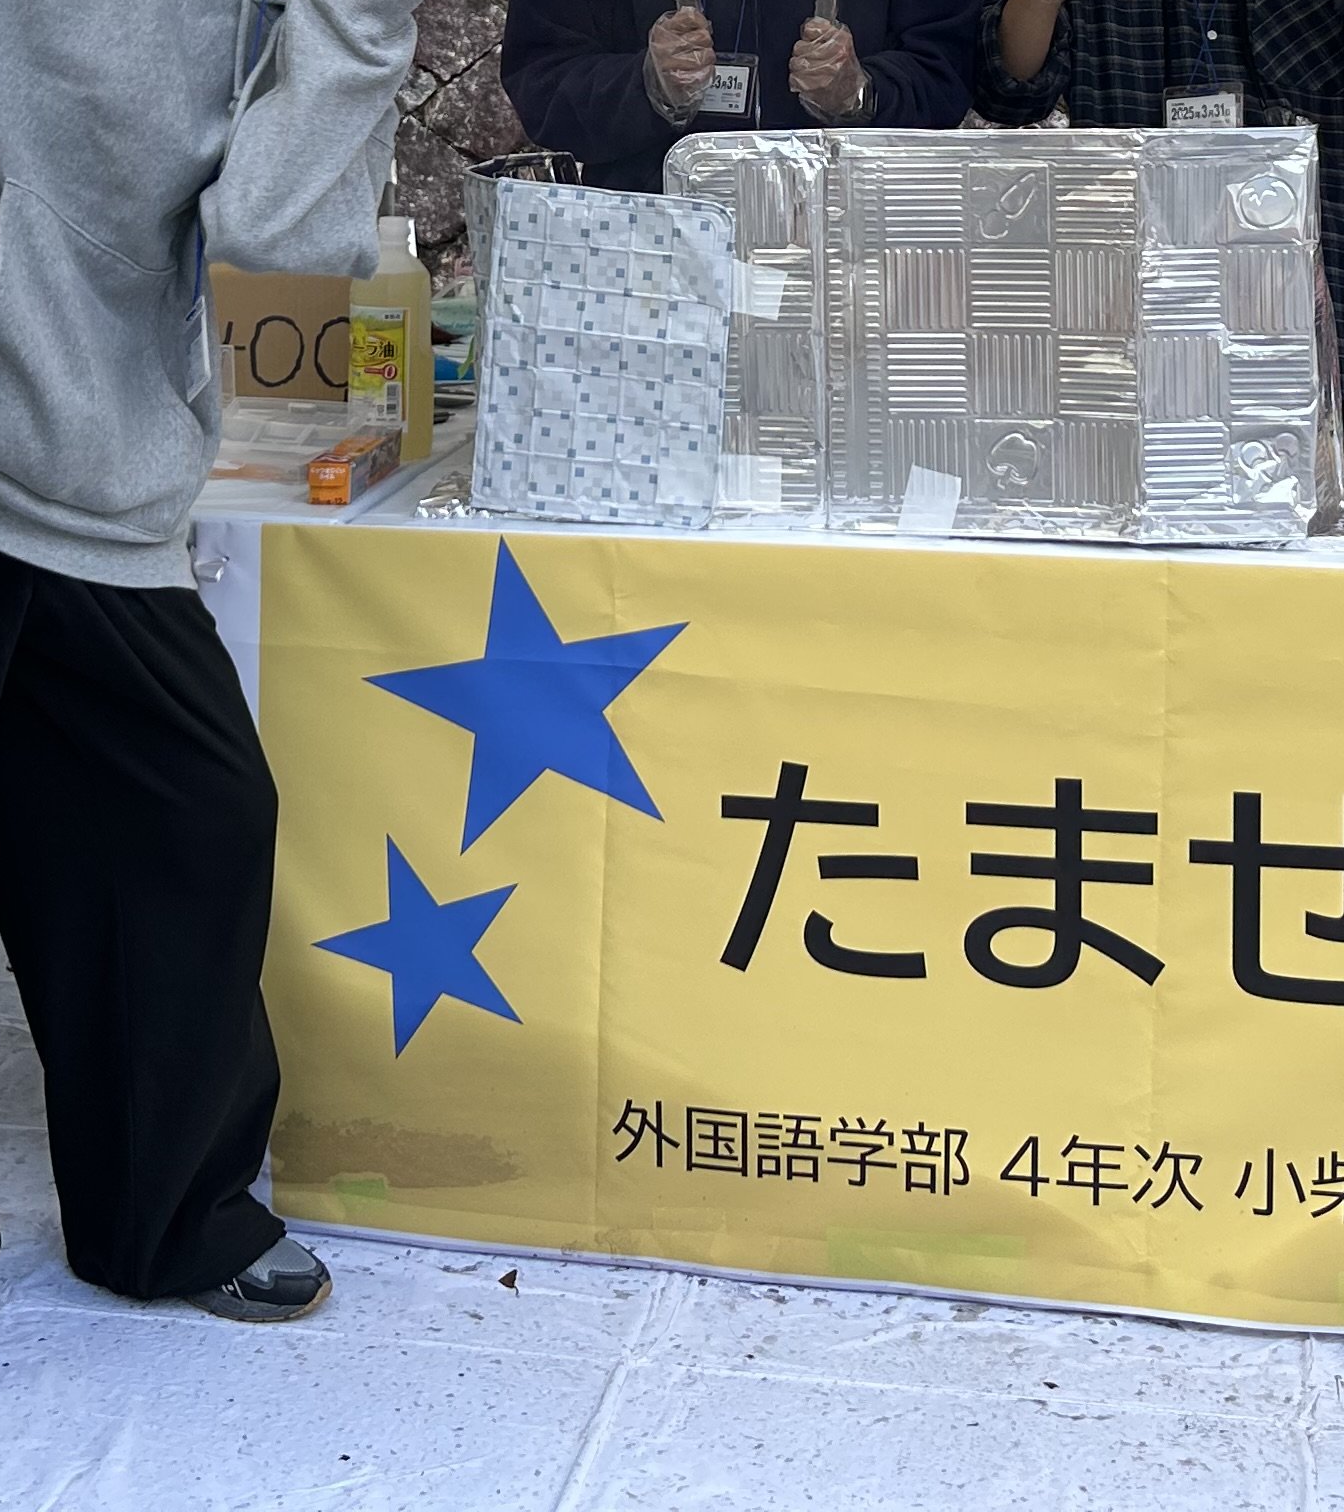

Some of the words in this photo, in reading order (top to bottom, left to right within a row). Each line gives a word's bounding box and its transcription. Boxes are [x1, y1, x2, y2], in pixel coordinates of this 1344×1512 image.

[612, 1099, 970, 1196] 外国語学部
[1000, 1134, 1204, 1211] 4年次
